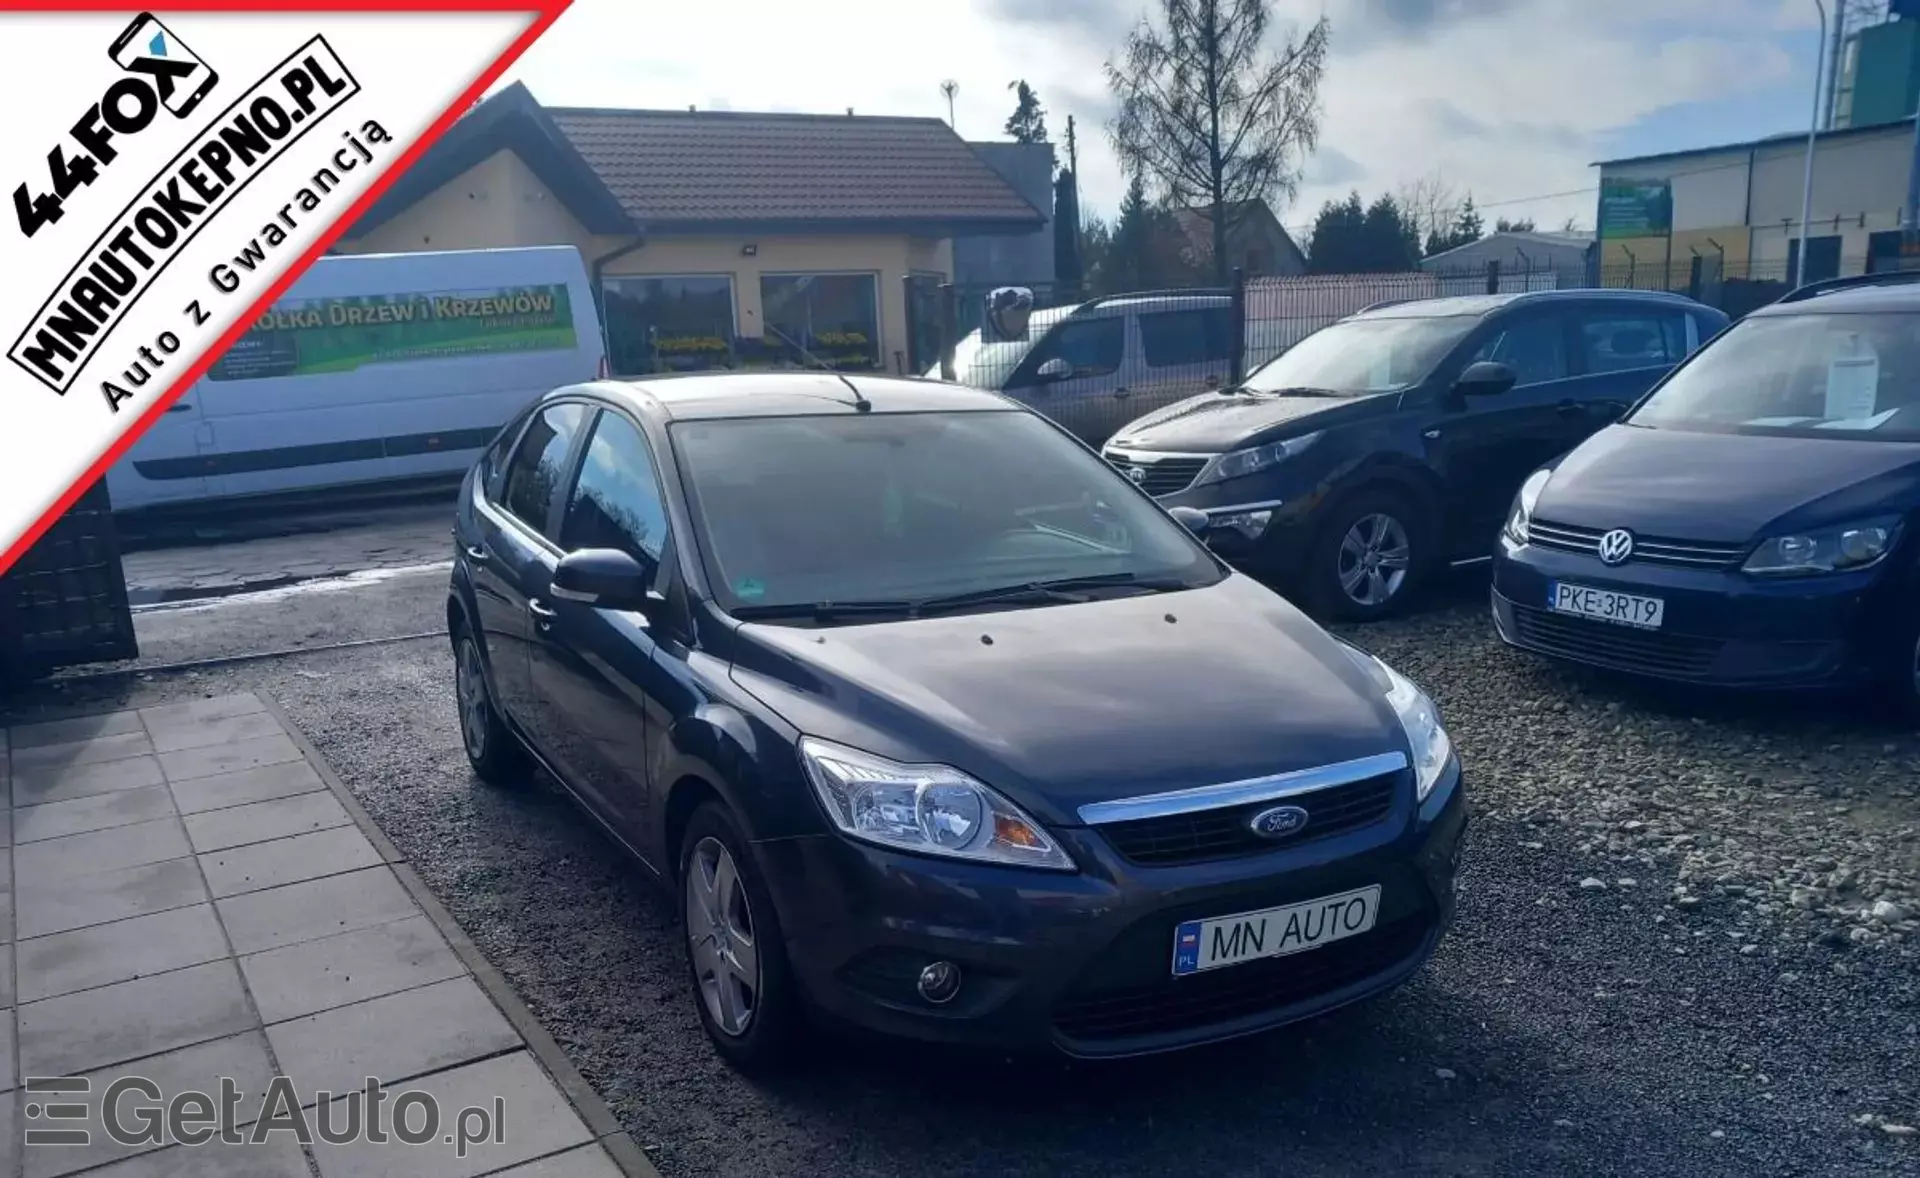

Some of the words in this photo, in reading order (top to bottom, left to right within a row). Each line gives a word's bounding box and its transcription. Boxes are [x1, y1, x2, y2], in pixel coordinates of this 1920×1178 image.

[434, 291, 552, 319] KRZEWÓW
[1267, 813, 1297, 832] Ford
[1210, 918, 1267, 962] MN
[1278, 897, 1367, 949] AUTO
[1178, 956, 1195, 967] PL
